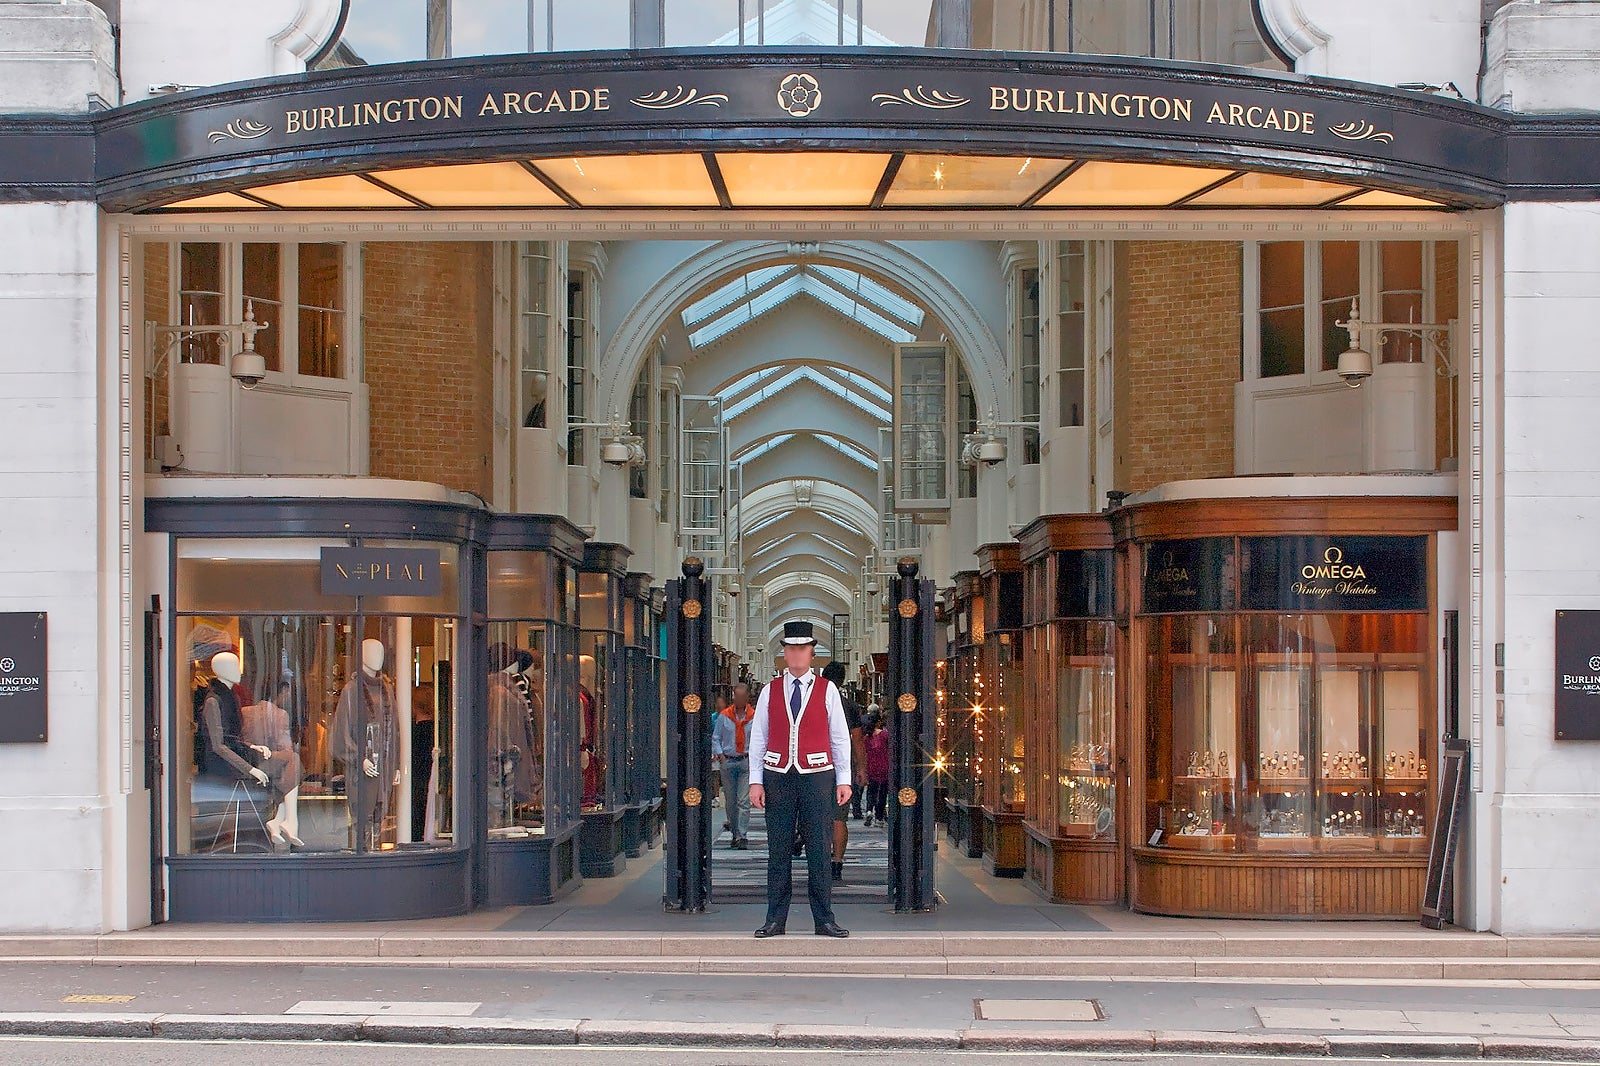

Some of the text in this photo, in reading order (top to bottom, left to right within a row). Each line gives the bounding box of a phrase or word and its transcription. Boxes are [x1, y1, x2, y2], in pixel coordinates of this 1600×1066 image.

[285, 88, 610, 134] BURLINGTON ARCADE
[989, 86, 1316, 135] BURLINGTON ARCADE
[1302, 565, 1366, 579] OMEGA
[1291, 580, 1377, 599] Vintage Watches
